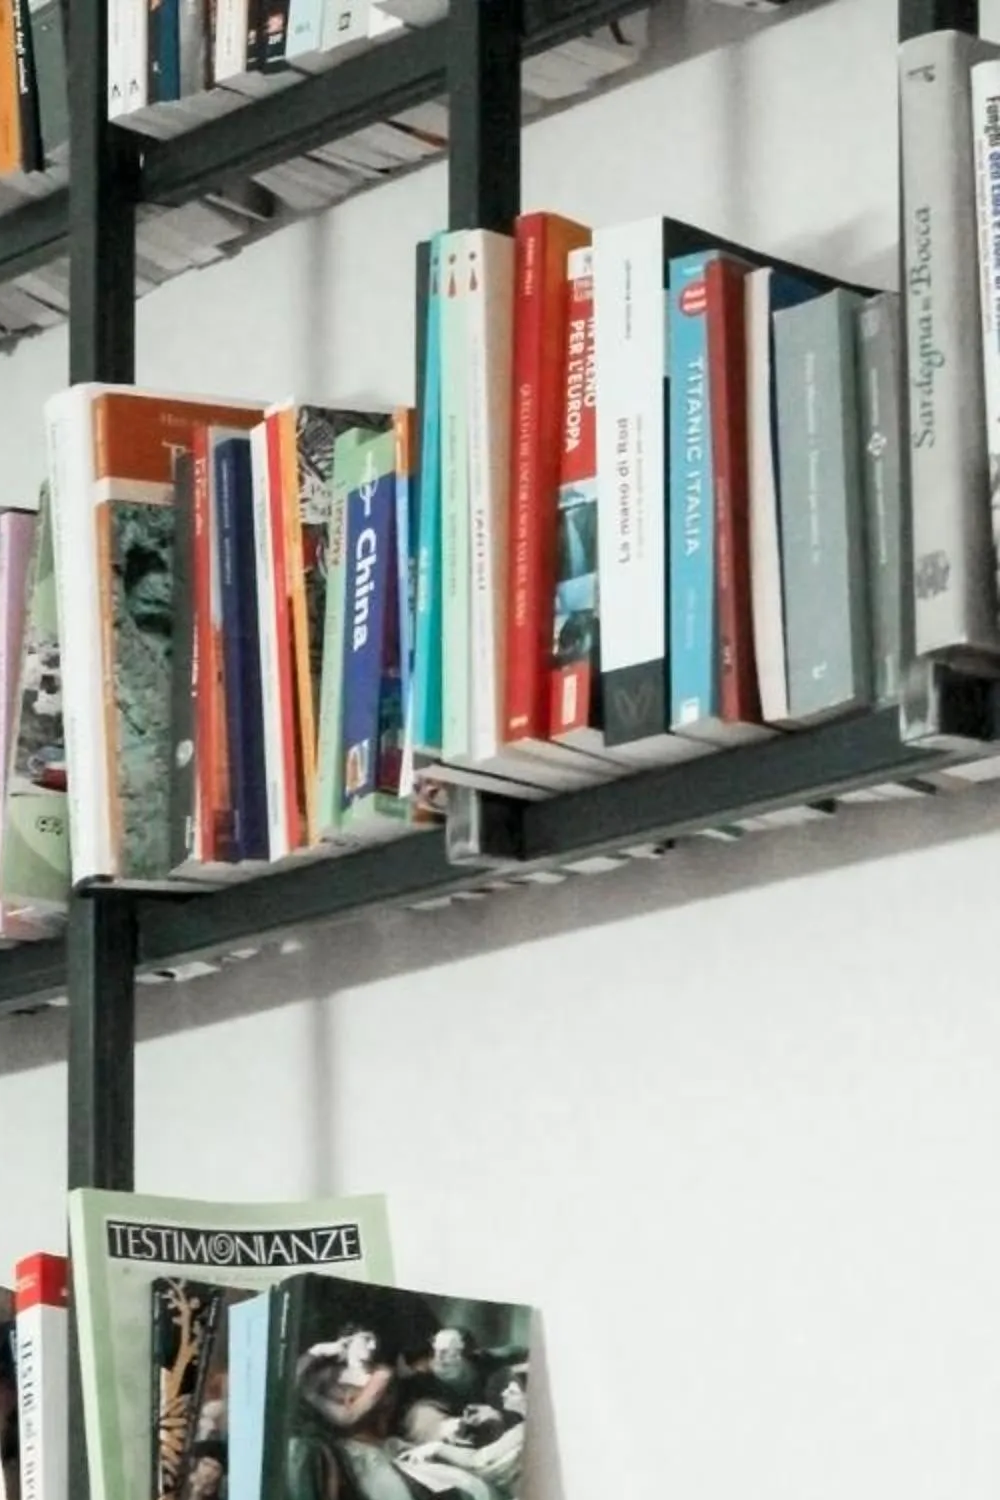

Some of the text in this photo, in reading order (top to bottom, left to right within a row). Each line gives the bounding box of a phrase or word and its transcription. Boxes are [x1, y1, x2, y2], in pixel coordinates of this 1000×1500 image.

[908, 205, 934, 296] Bocca
[565, 320, 585, 454] PER L'EUROPA
[912, 314, 945, 449] Sardegna
[684, 356, 704, 556] TITANIC ITALIA
[353, 528, 377, 652] China
[108, 1222, 359, 1265] TESTIMONIANZE
